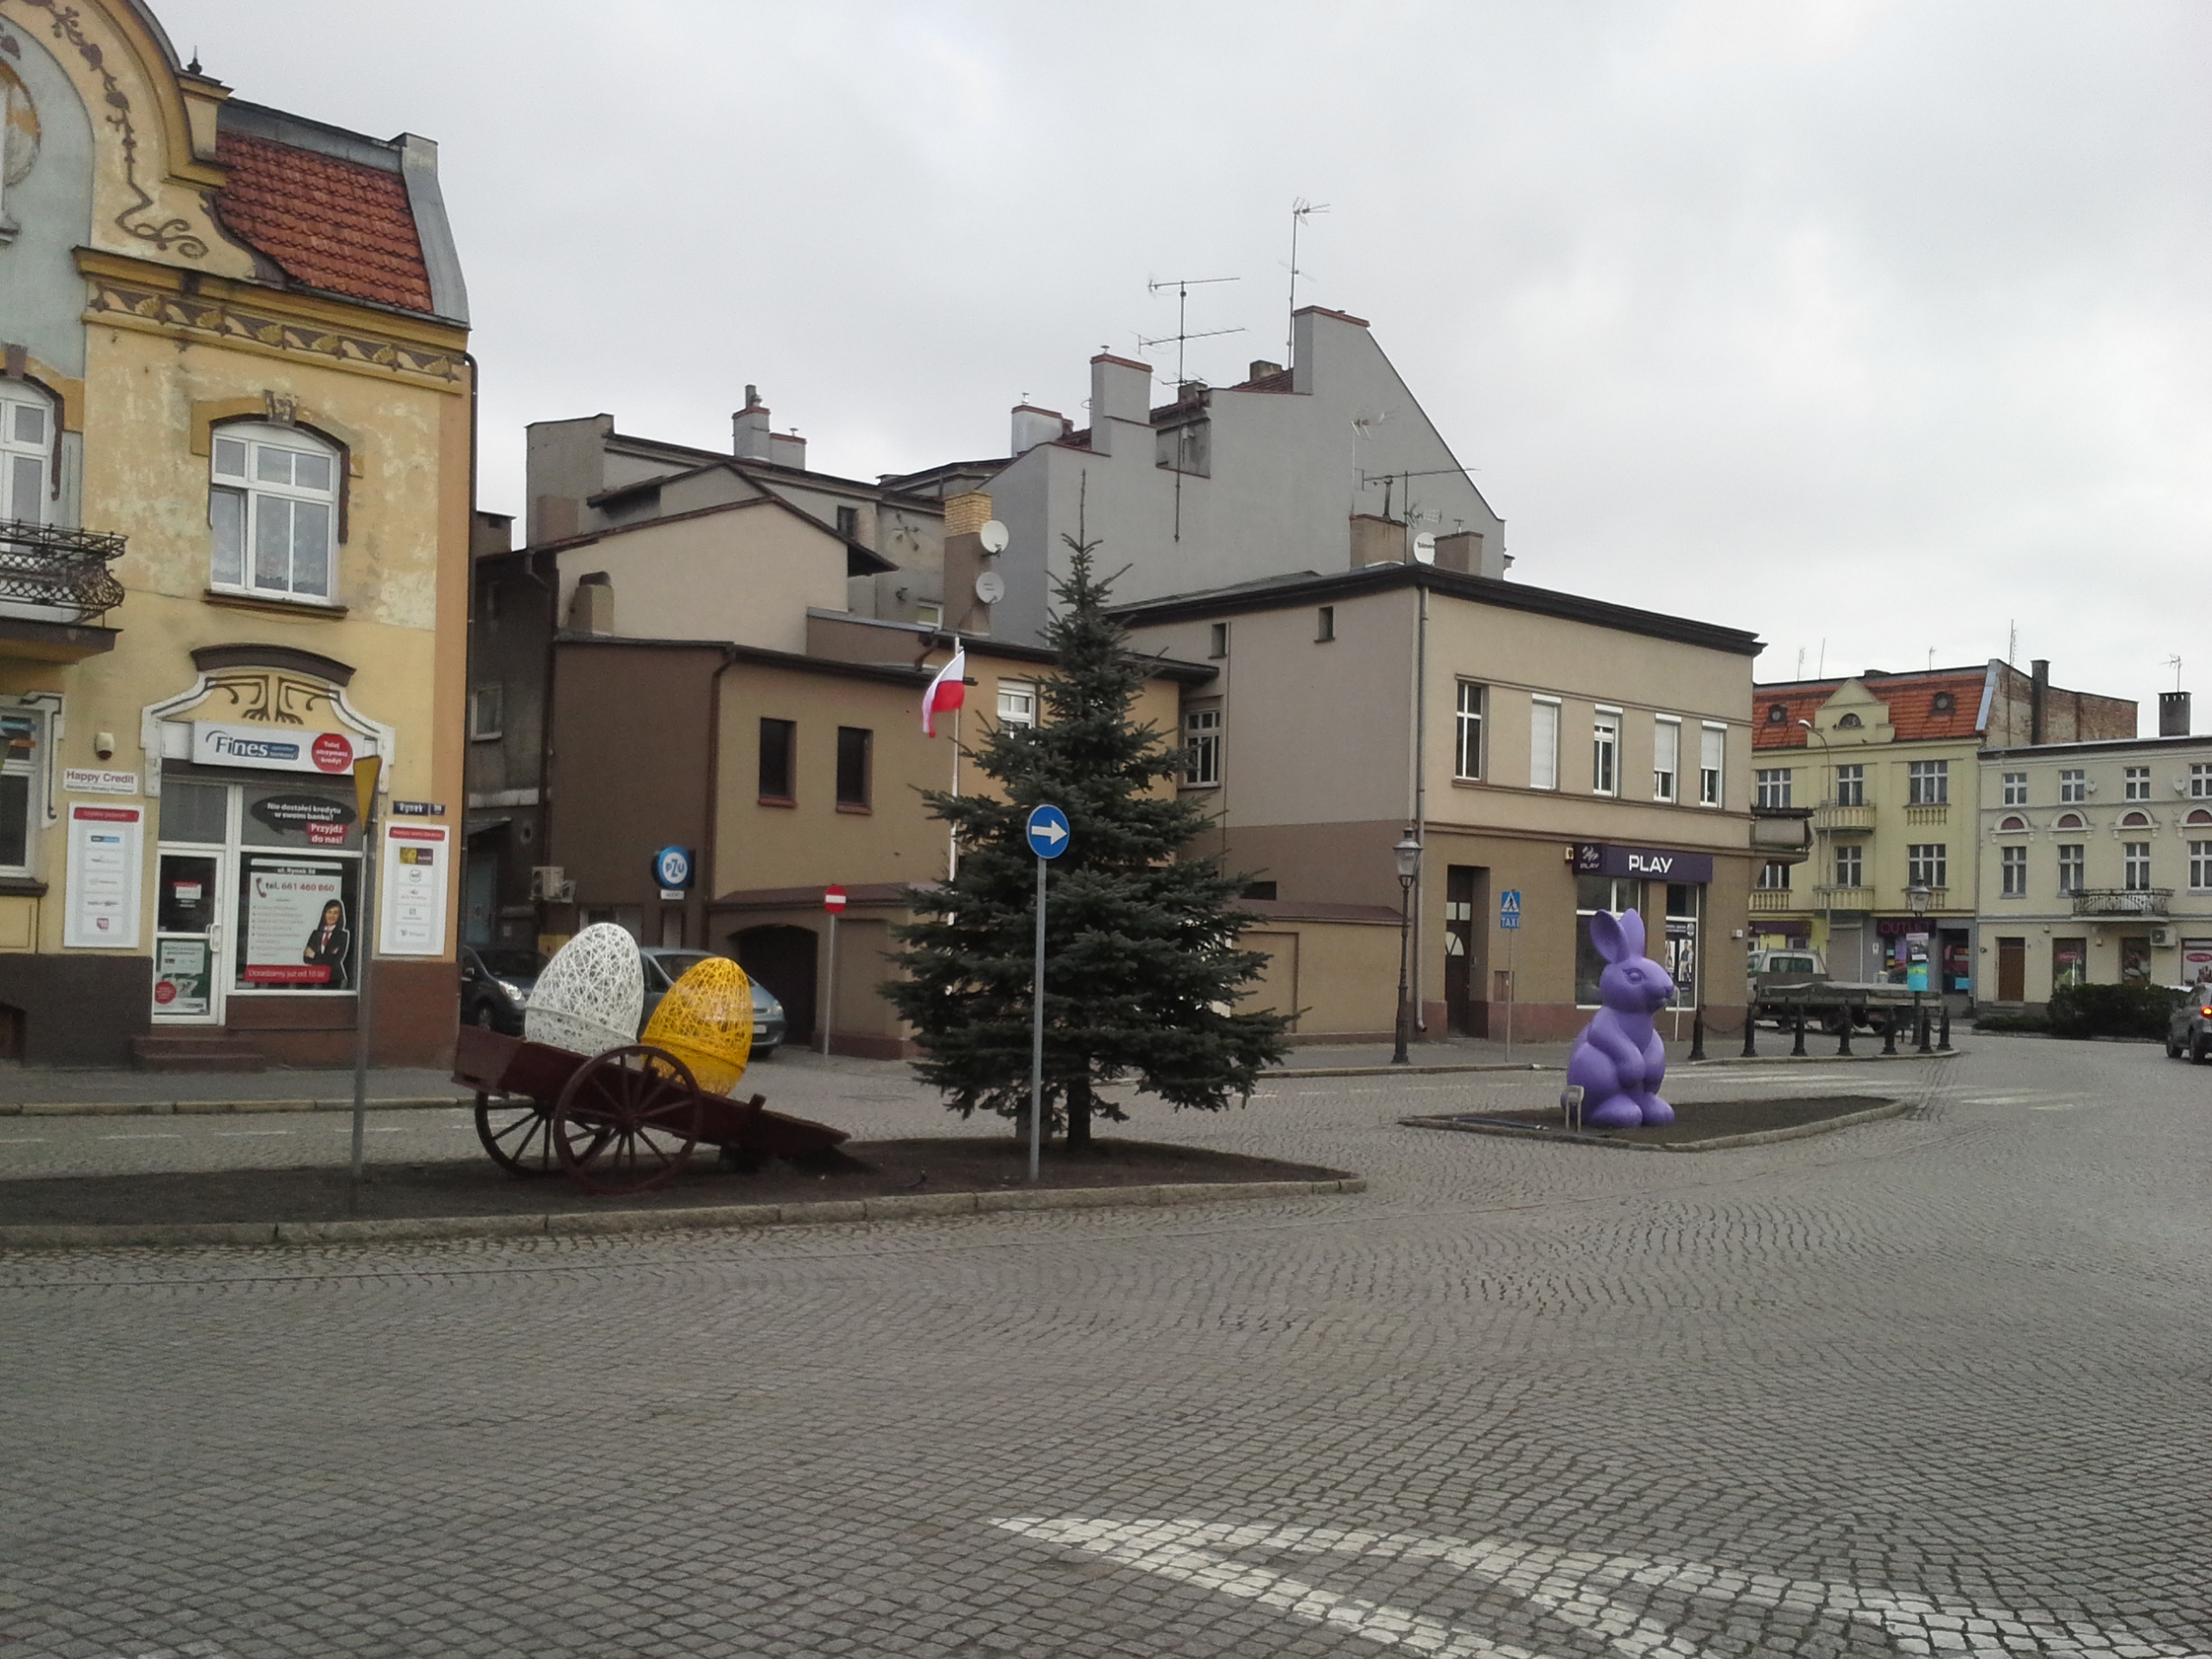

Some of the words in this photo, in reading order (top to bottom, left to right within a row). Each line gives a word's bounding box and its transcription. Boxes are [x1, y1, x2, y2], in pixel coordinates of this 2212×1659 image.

[215, 736, 269, 758] Fines
[67, 771, 100, 783] Happy
[103, 773, 134, 784] Credit
[313, 805, 341, 815] kredytu
[399, 802, 423, 814] Rynek
[311, 835, 323, 843] do
[325, 836, 343, 844] nas!
[665, 858, 684, 877] PZU
[1629, 855, 1673, 874] PLAY
[1501, 917, 1519, 927] TAXI
